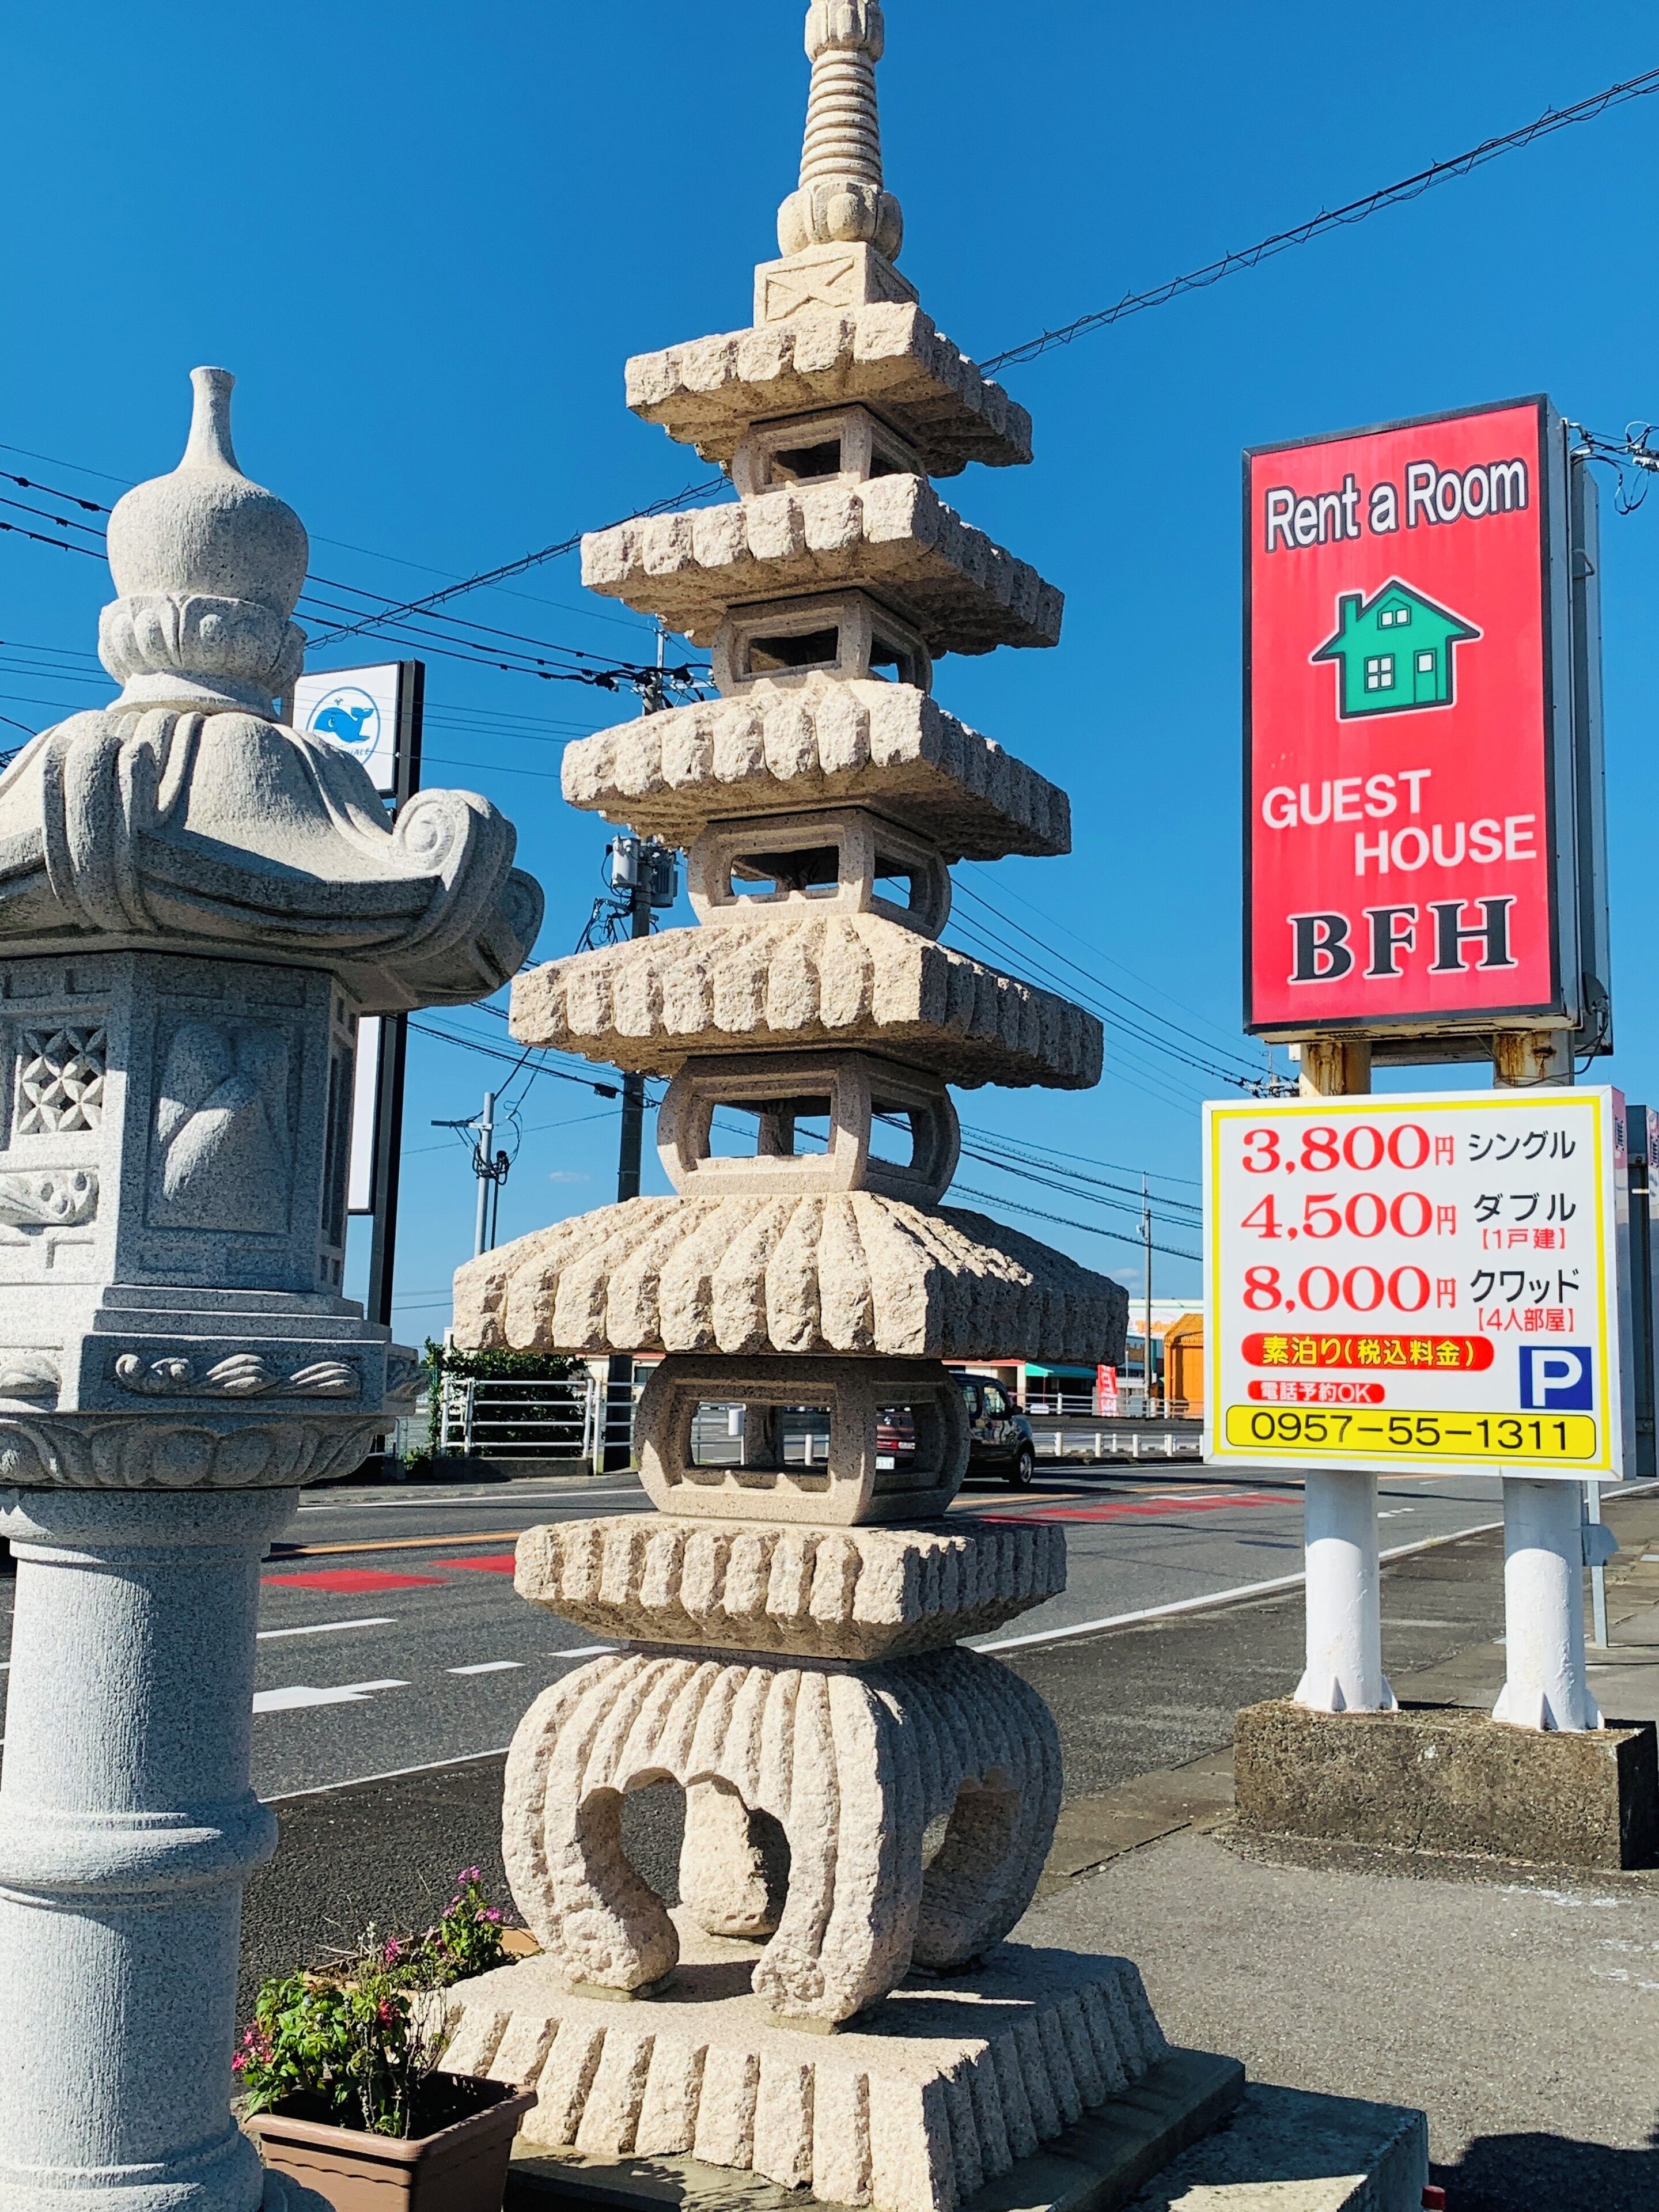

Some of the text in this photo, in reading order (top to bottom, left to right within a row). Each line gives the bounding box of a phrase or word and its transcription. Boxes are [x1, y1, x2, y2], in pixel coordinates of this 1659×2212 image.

[1266, 457, 1528, 552] Rent a Room
[1262, 768, 1431, 829] GUEST
[1354, 814, 1537, 877] HOUSE
[1287, 895, 1518, 984] BFH
[1241, 1124, 1454, 1175] 3,800円
[1468, 1130, 1576, 1161] シングル
[1241, 1191, 1576, 1241] 4,500円 ダブル
[1243, 1266, 1580, 1313] 8,000円 クワッド
[1262, 1335, 1474, 1367] 素泊り(税込料金)
[1261, 1382, 1372, 1403] 電話予約OK
[1251, 1412, 1567, 1450] 0957-55-1311
